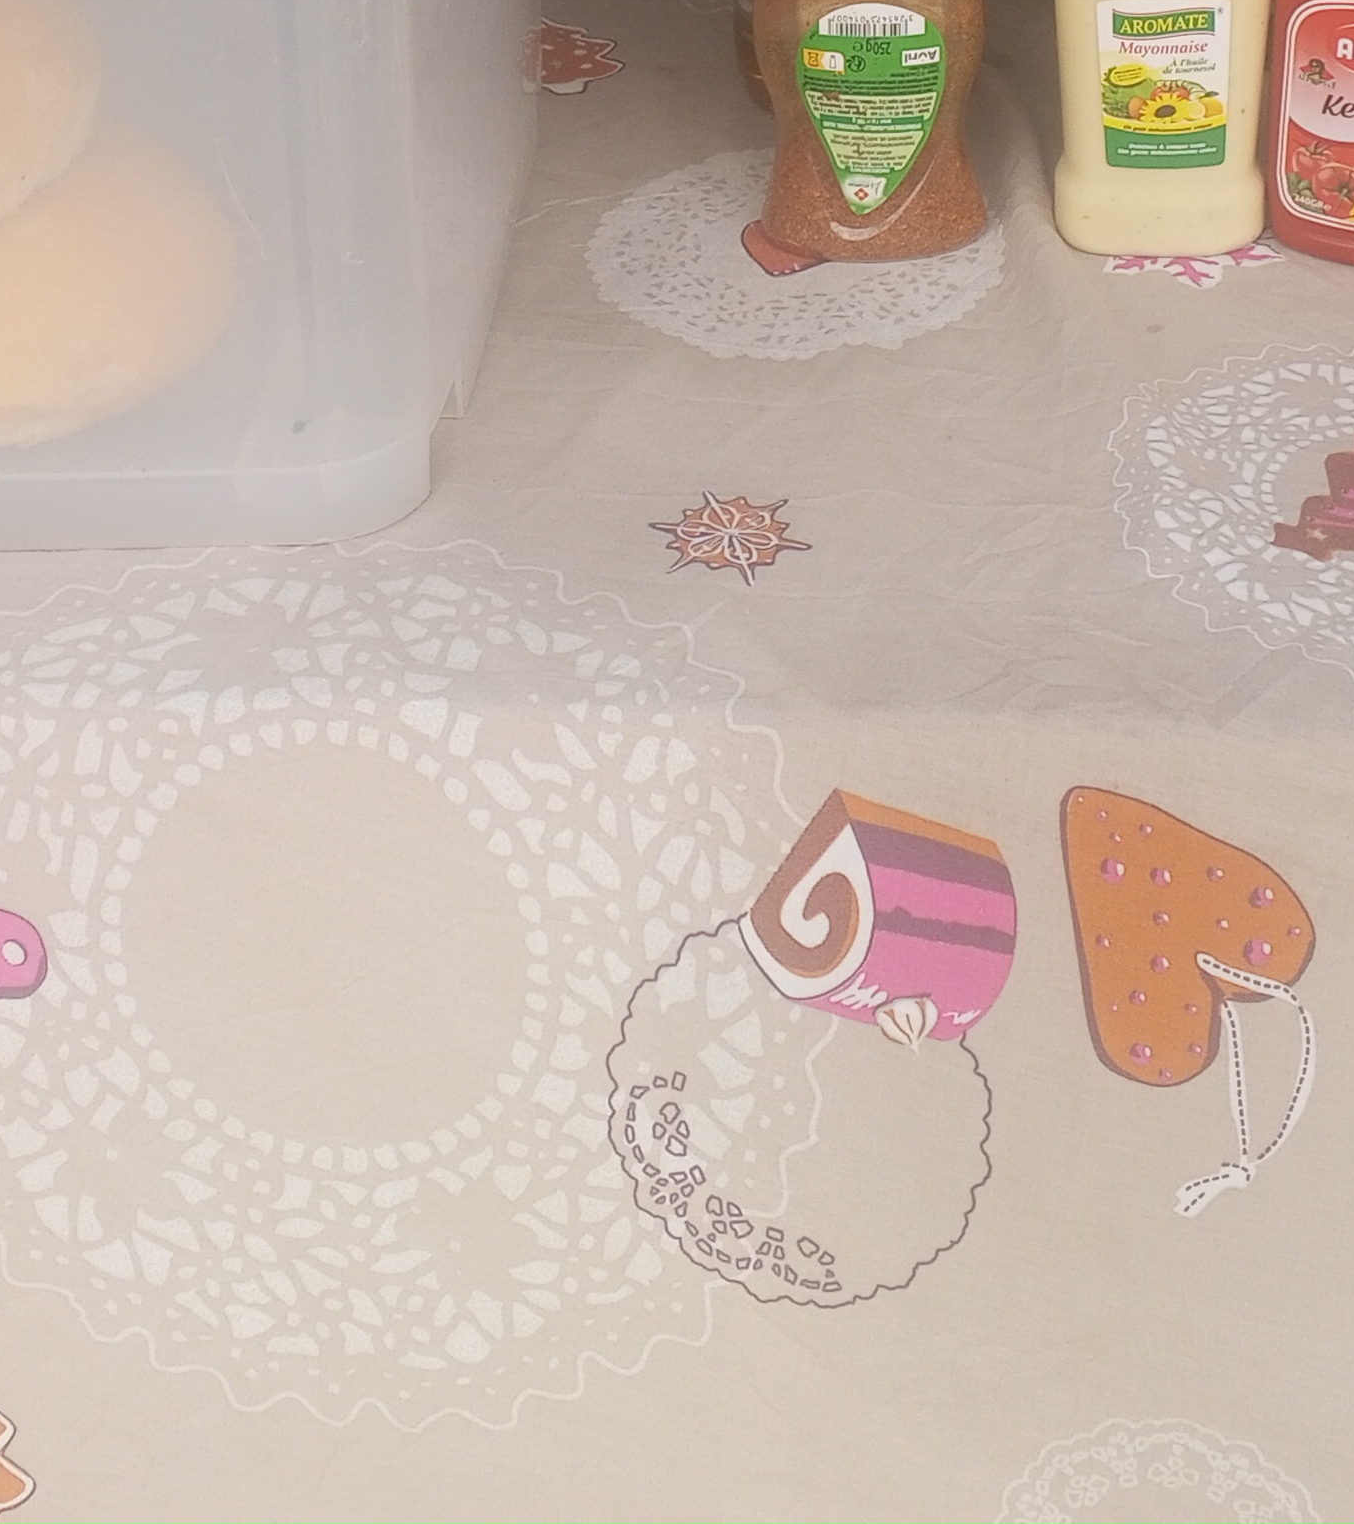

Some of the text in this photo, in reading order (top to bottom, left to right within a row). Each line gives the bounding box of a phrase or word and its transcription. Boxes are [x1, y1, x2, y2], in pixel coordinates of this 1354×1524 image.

[1120, 14, 1208, 34] AROMATE
[866, 39, 891, 55] 250g
[1119, 40, 1208, 58] Mayonnaise
